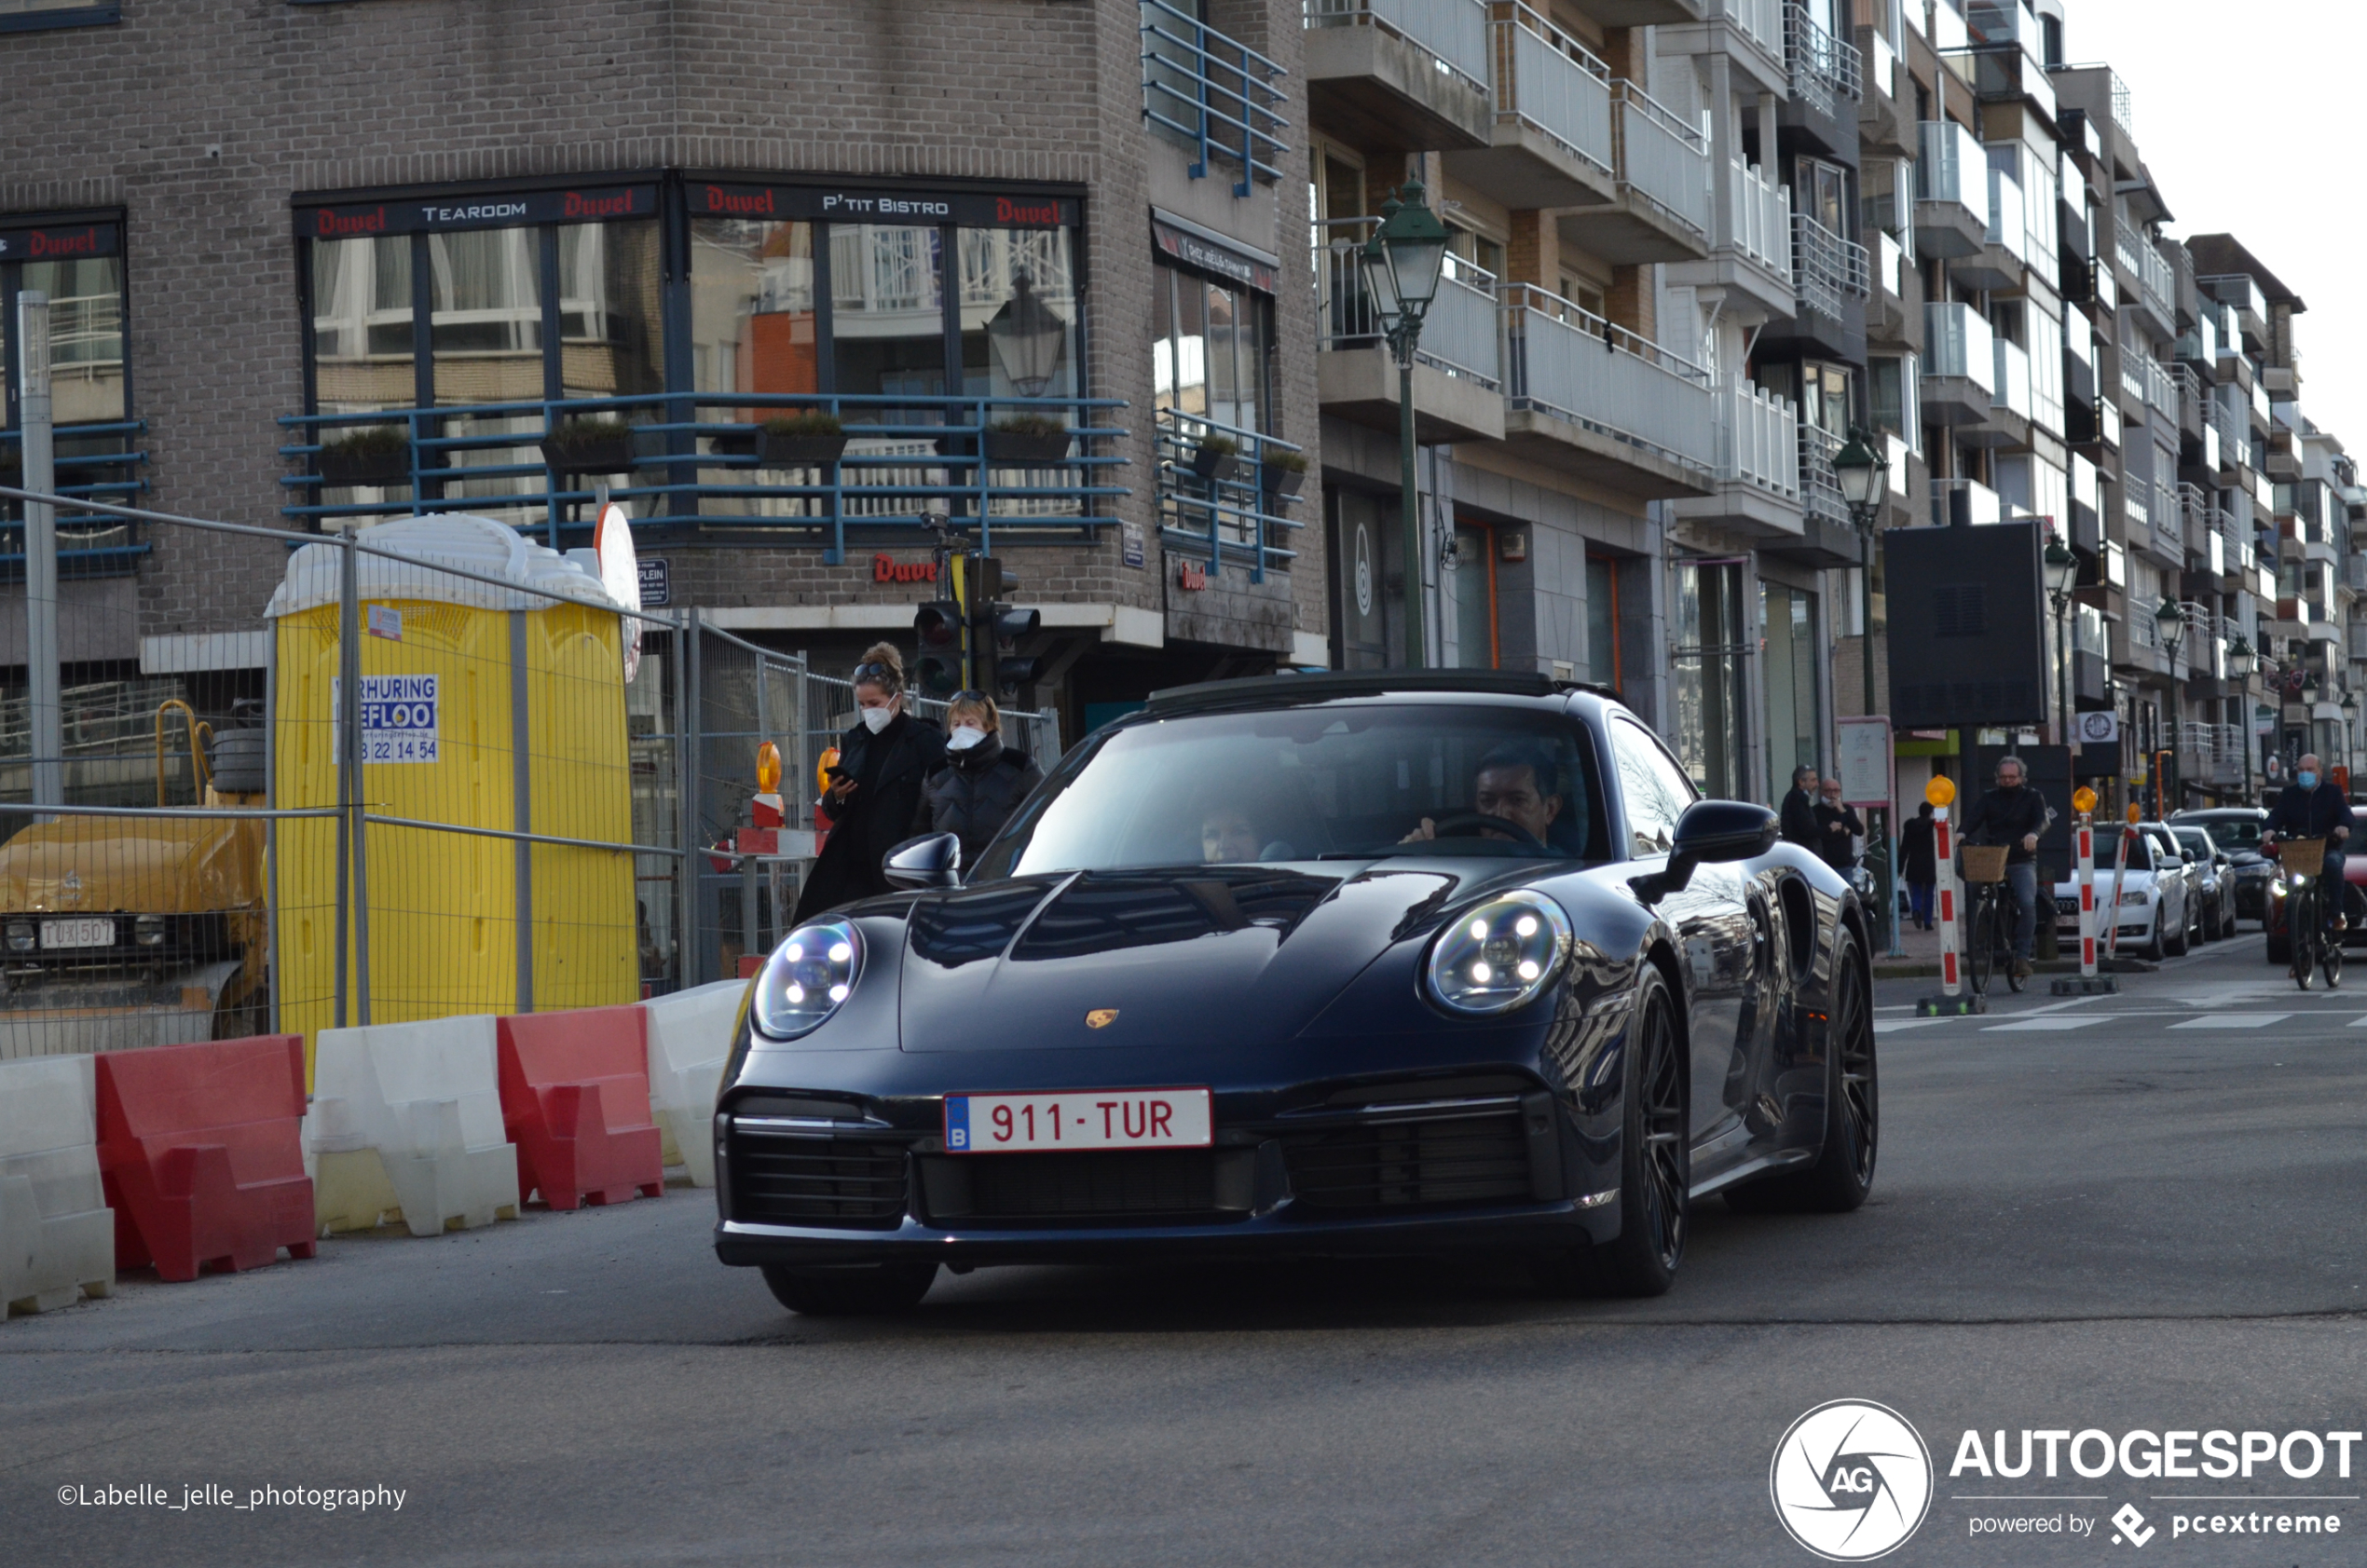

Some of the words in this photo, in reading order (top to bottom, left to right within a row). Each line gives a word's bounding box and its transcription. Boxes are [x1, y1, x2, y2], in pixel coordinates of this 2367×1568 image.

[422, 202, 527, 222] TEAROOM
[565, 188, 633, 216] Duvel
[705, 185, 774, 213] Duvel
[879, 198, 949, 215] BISTRO
[996, 196, 1061, 225] Duvel
[318, 206, 386, 235] Duvel
[30, 226, 96, 256] Duvel
[637, 569, 664, 580] PLEIN
[1182, 561, 1207, 592] Duvel
[361, 703, 431, 728] EFLOO
[375, 742, 390, 759] 22
[398, 741, 414, 759] 14
[419, 740, 436, 759] 54
[951, 1128, 966, 1147] B
